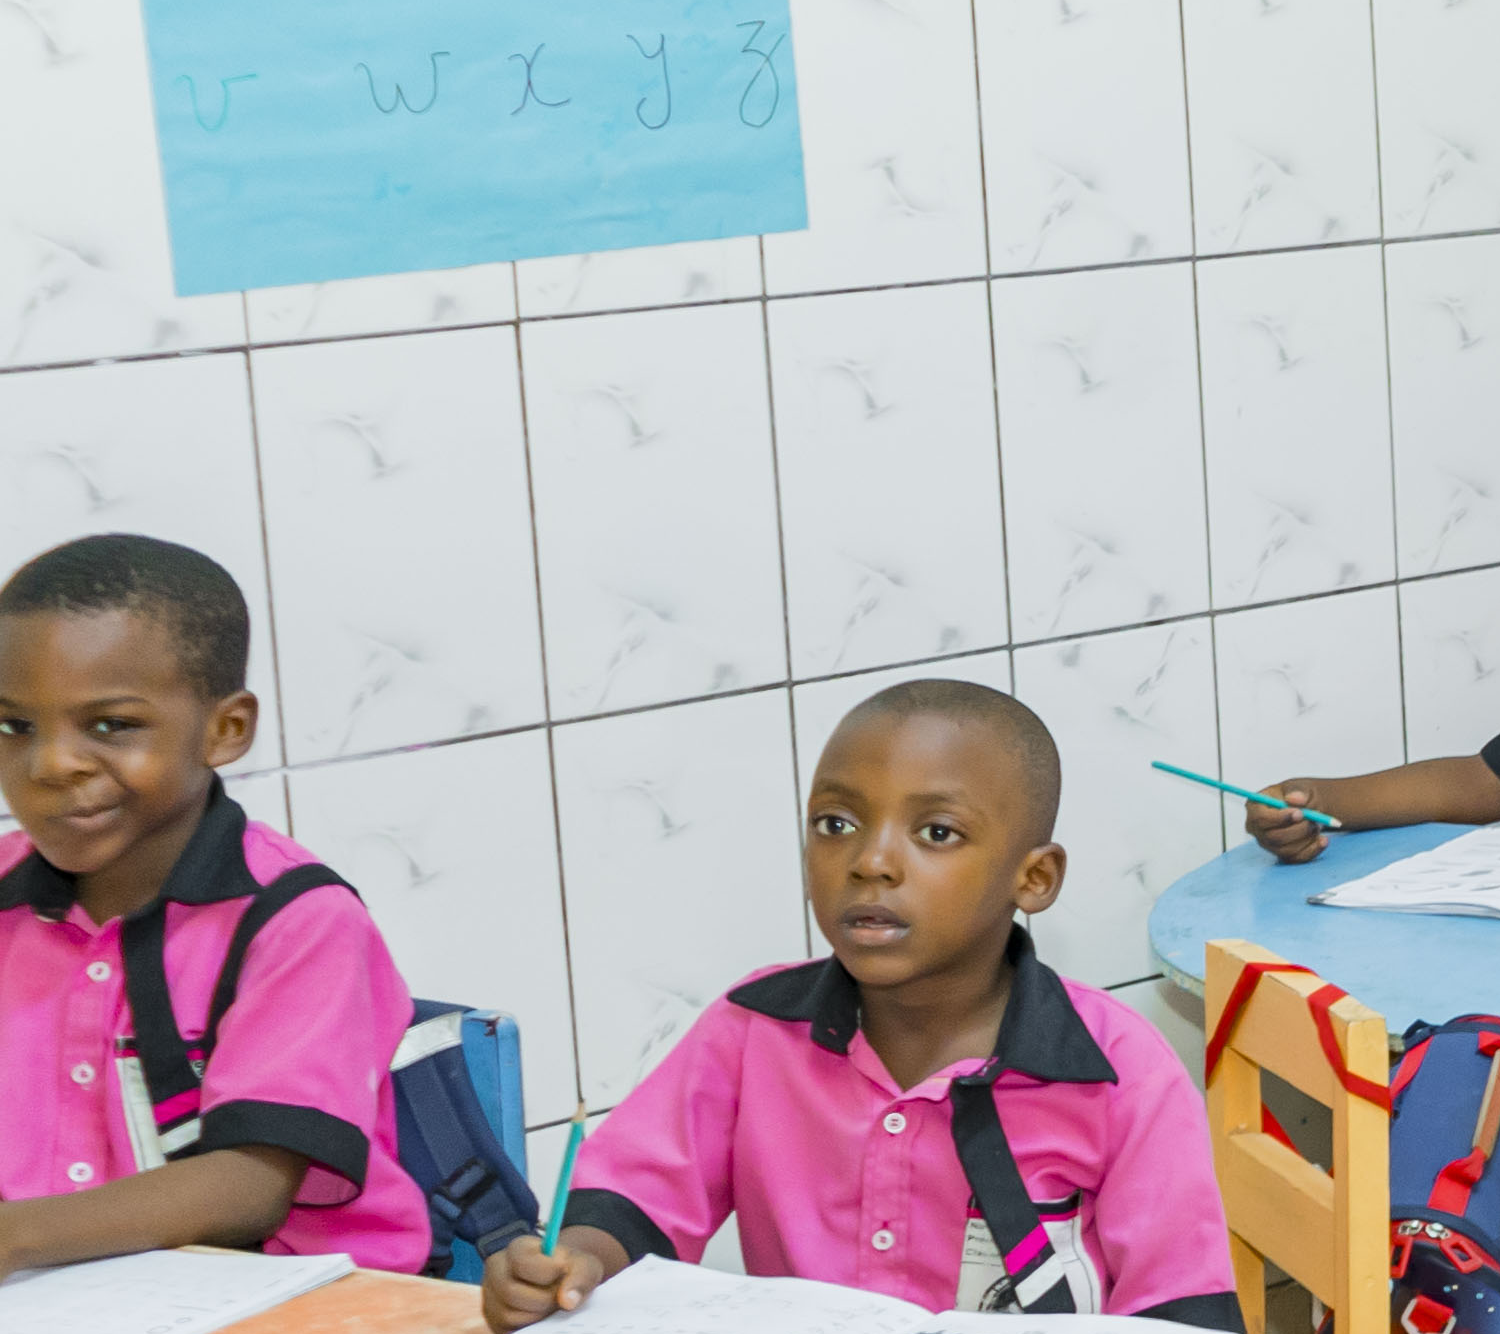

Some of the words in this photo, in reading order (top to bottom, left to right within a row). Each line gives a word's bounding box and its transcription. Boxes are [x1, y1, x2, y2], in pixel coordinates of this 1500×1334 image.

[173, 72, 257, 131] v
[354, 49, 449, 114] w
[508, 42, 571, 115] x
[626, 33, 671, 129] y
[735, 20, 785, 128] z
